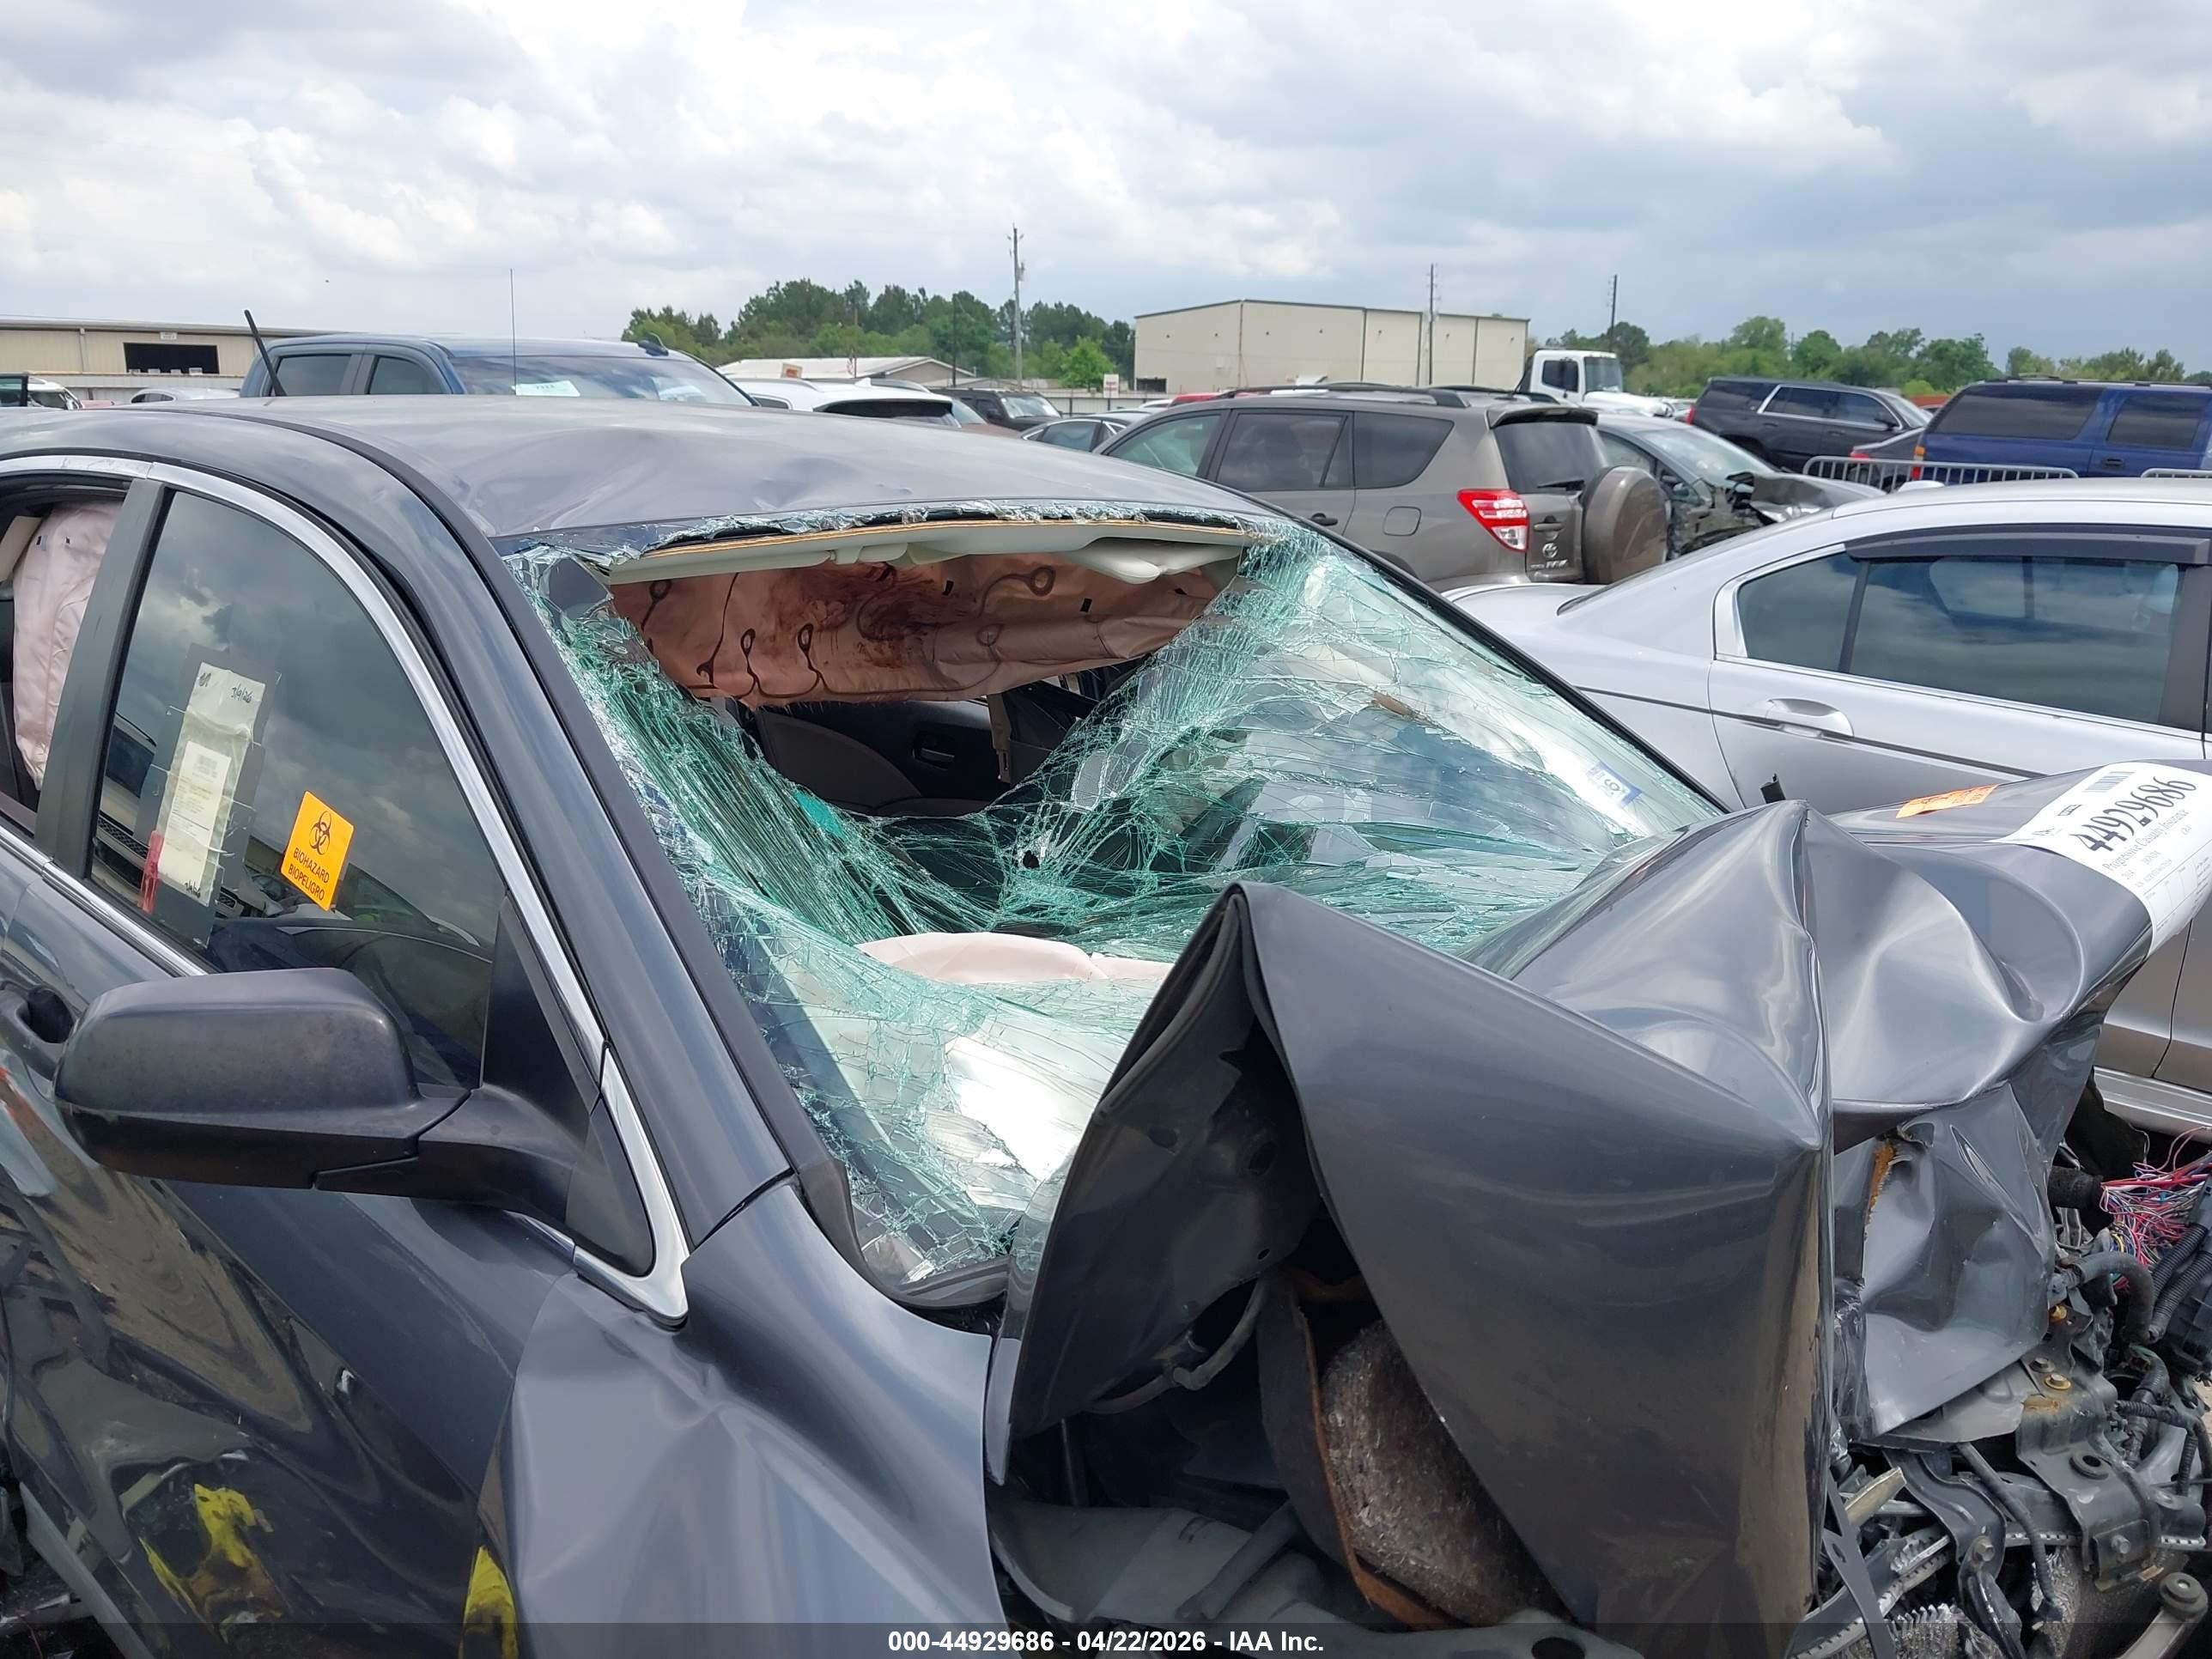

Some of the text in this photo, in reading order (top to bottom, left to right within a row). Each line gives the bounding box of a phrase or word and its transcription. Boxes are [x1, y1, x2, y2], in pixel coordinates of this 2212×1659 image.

[2069, 776, 2197, 852] 44929686
[293, 847, 330, 884] BIOHAZARD
[2102, 844, 2142, 872] Progressive
[2135, 826, 2168, 847] Casualty
[2158, 809, 2190, 830] Insurance
[288, 862, 325, 901] BIOPELIGRO
